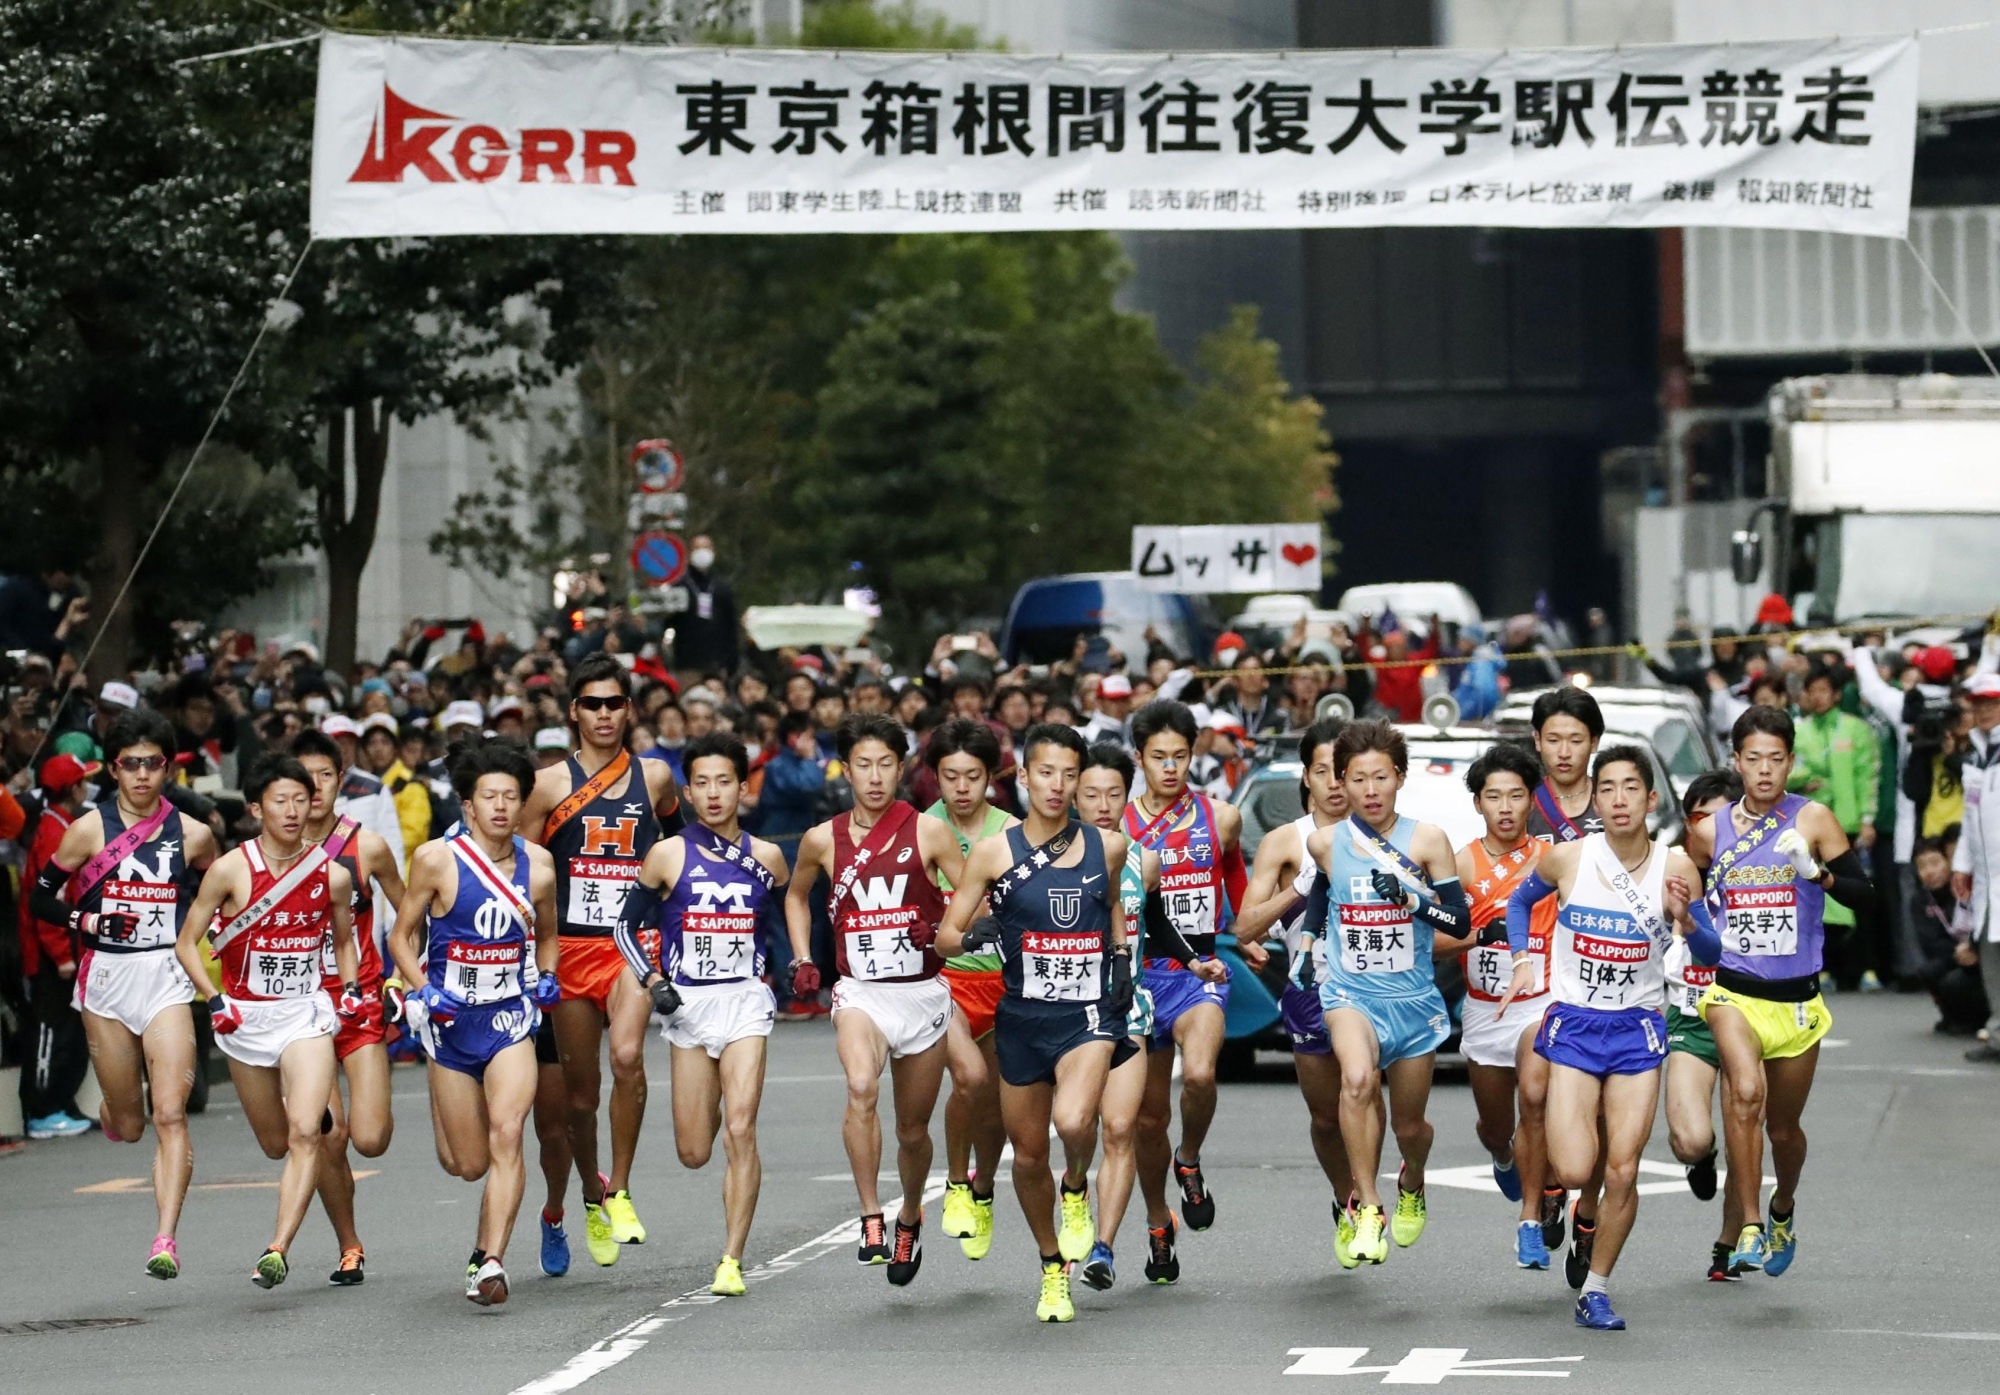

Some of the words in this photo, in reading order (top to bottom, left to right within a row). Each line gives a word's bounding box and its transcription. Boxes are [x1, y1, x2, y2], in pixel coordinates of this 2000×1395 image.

[676, 67, 1875, 158] 東京箱根間往復大学駅伝競走
[1139, 540, 1267, 577] ムッサ
[580, 815, 639, 856] H
[1155, 844, 1213, 866] 価大学
[117, 850, 173, 884] N
[588, 862, 642, 878] SAPPORO
[1724, 864, 1796, 886] 央学院大学
[1160, 871, 1212, 888] SAPPORO
[121, 885, 177, 900] SAPPORO
[687, 881, 753, 913] M
[851, 874, 909, 912] W
[1733, 890, 1794, 905] SAPPORO
[700, 916, 754, 931] SAPPORO
[858, 910, 917, 928] SAPPORO
[1351, 907, 1409, 922] SAPPORO
[1427, 906, 1457, 925] TOKAI
[1727, 908, 1794, 935] 中央学大
[694, 935, 746, 958] 明大
[857, 930, 910, 958] 早大
[1041, 936, 1100, 951] SAPPORO
[1346, 927, 1405, 952] 東海大
[1739, 936, 1777, 954] 9-1
[465, 947, 519, 961] SAPPORO
[1588, 942, 1648, 959] SAPPORO
[259, 954, 315, 978] 帝京大
[865, 958, 904, 977] 4-1
[1032, 955, 1094, 981] 東洋大
[1355, 953, 1394, 971] 5-1
[458, 965, 510, 990] 順大
[1579, 958, 1638, 987] 日体大
[263, 978, 312, 995] 10-12
[1043, 982, 1081, 999] 2-1
[1586, 985, 1624, 1005] 7-1
